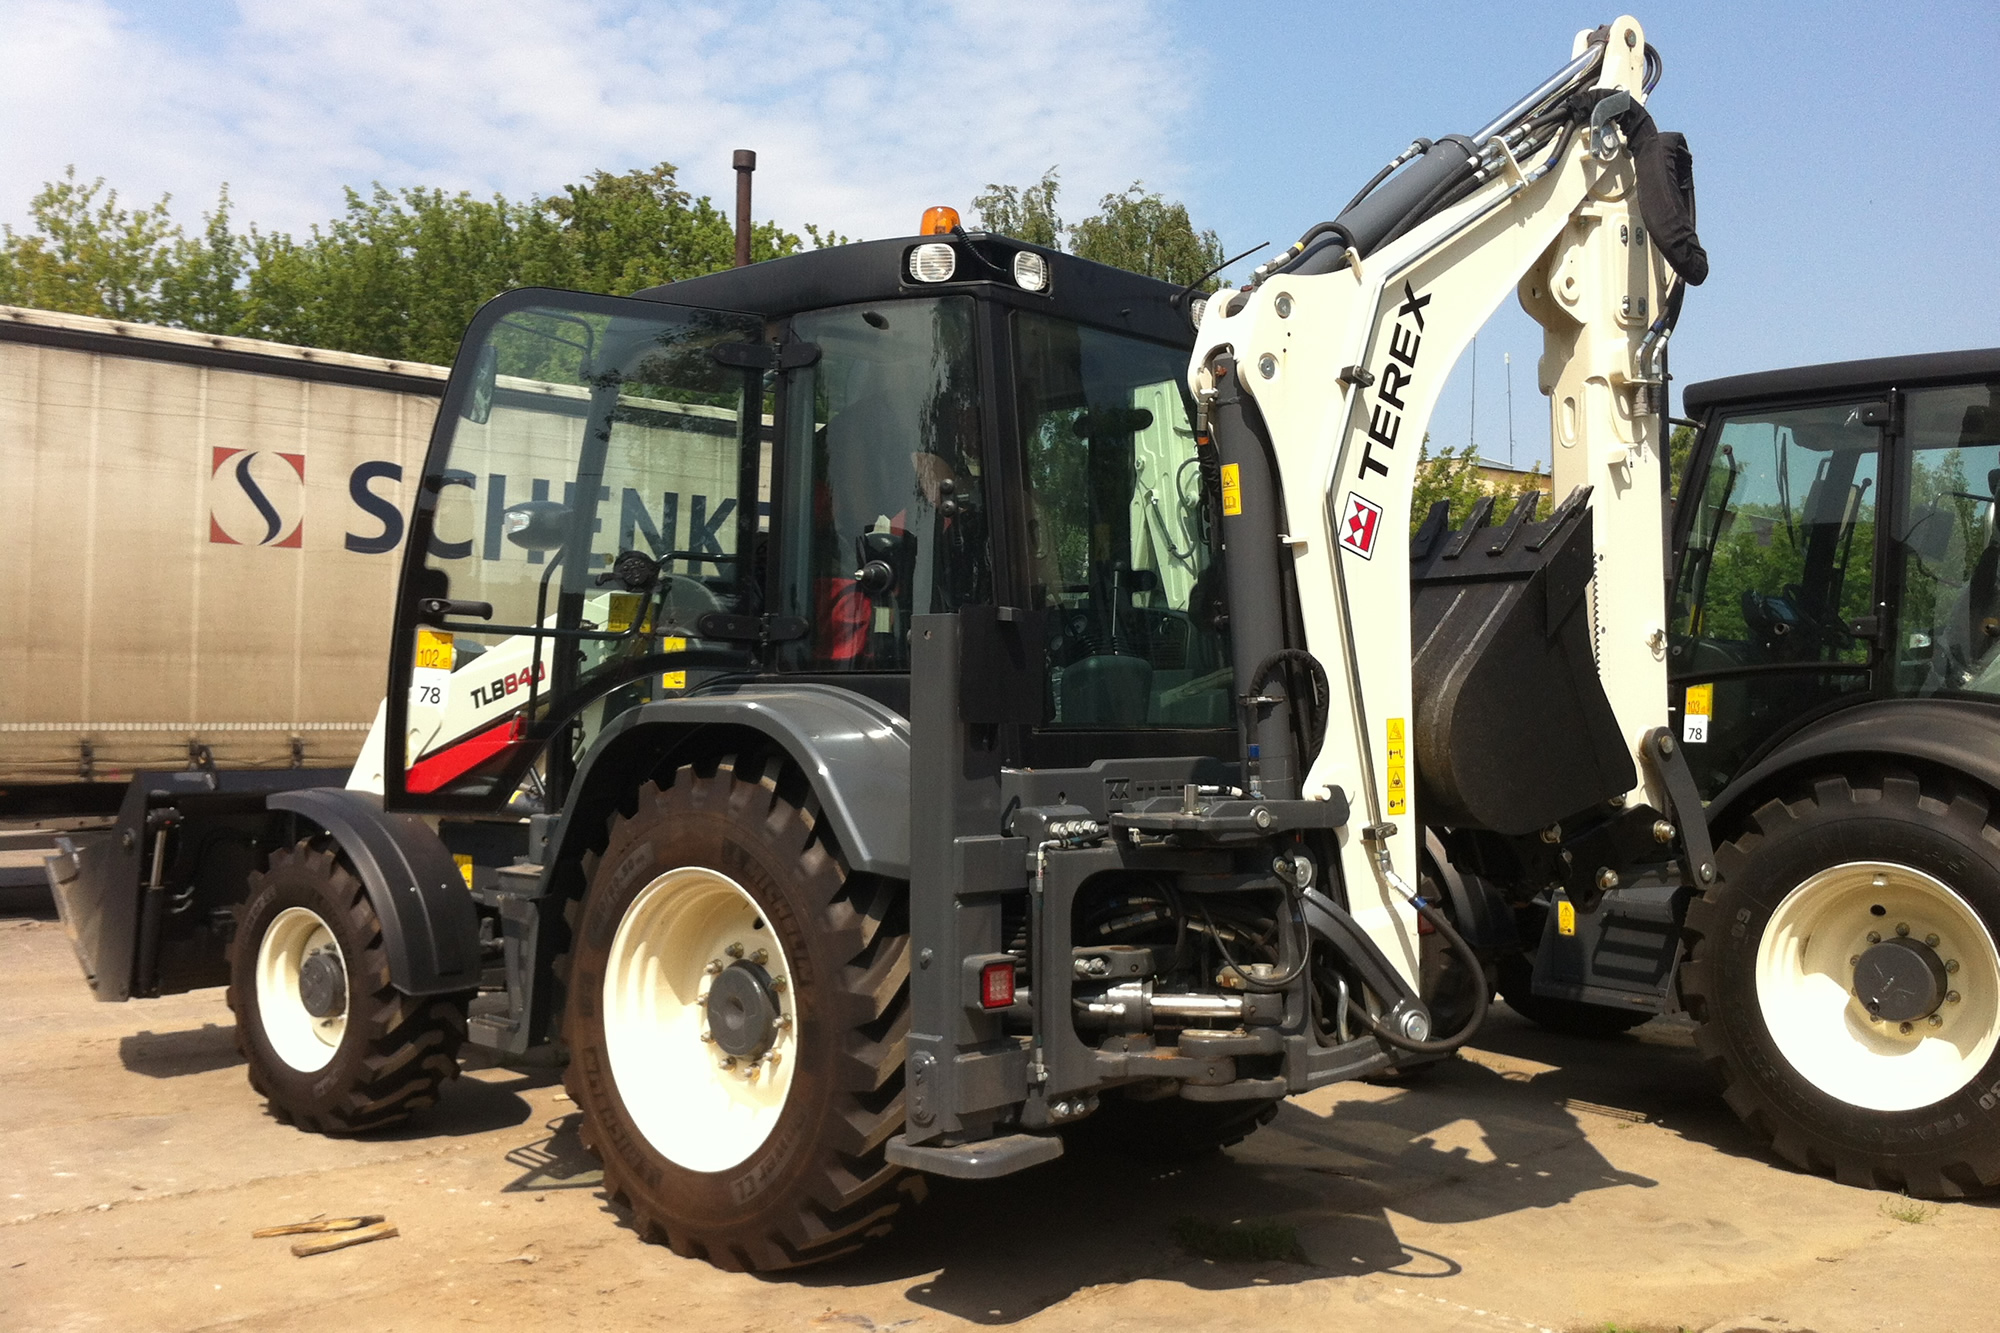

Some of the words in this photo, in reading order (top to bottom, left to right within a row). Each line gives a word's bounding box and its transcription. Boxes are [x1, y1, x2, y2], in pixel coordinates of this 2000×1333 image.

[1358, 280, 1432, 480] TEREX
[419, 649, 440, 667] 102
[470, 660, 546, 709] TLB840
[420, 686, 441, 704] 78
[1687, 701, 1700, 714] 103
[1688, 727, 1703, 741] 78
